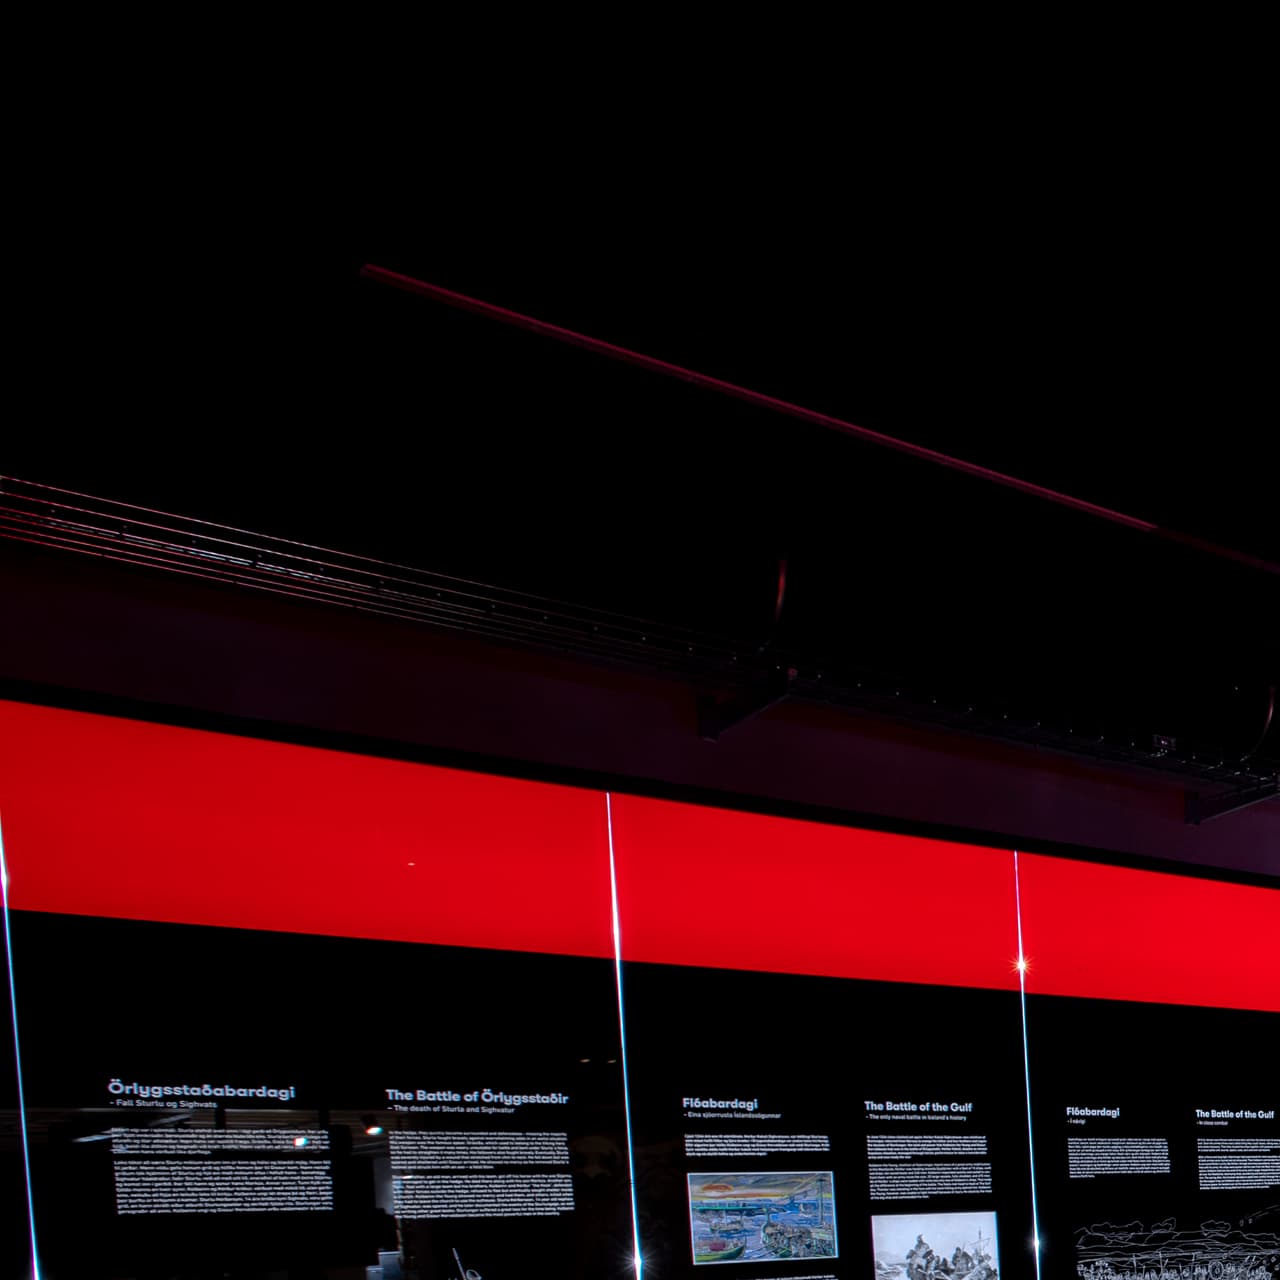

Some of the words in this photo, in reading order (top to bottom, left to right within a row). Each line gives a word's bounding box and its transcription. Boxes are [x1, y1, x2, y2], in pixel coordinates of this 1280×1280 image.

[107, 1078, 295, 1100] Örlygsstaðabardagi
[385, 1089, 414, 1101] The
[416, 1090, 461, 1101] Battle
[463, 1091, 479, 1102] of
[481, 1088, 569, 1106] Örlygsstaðir
[393, 1104, 408, 1112] The
[682, 1097, 758, 1111] Flóabardagi
[864, 1101, 884, 1111] The
[886, 1101, 917, 1111] Battle
[919, 1102, 930, 1111] of
[932, 1102, 948, 1112] the
[950, 1102, 973, 1112] Gulf
[1195, 1109, 1209, 1118] The
[1211, 1109, 1234, 1118] Battle
[1235, 1110, 1243, 1118] of
[1244, 1110, 1257, 1118] the
[1258, 1110, 1275, 1119] Gulf
